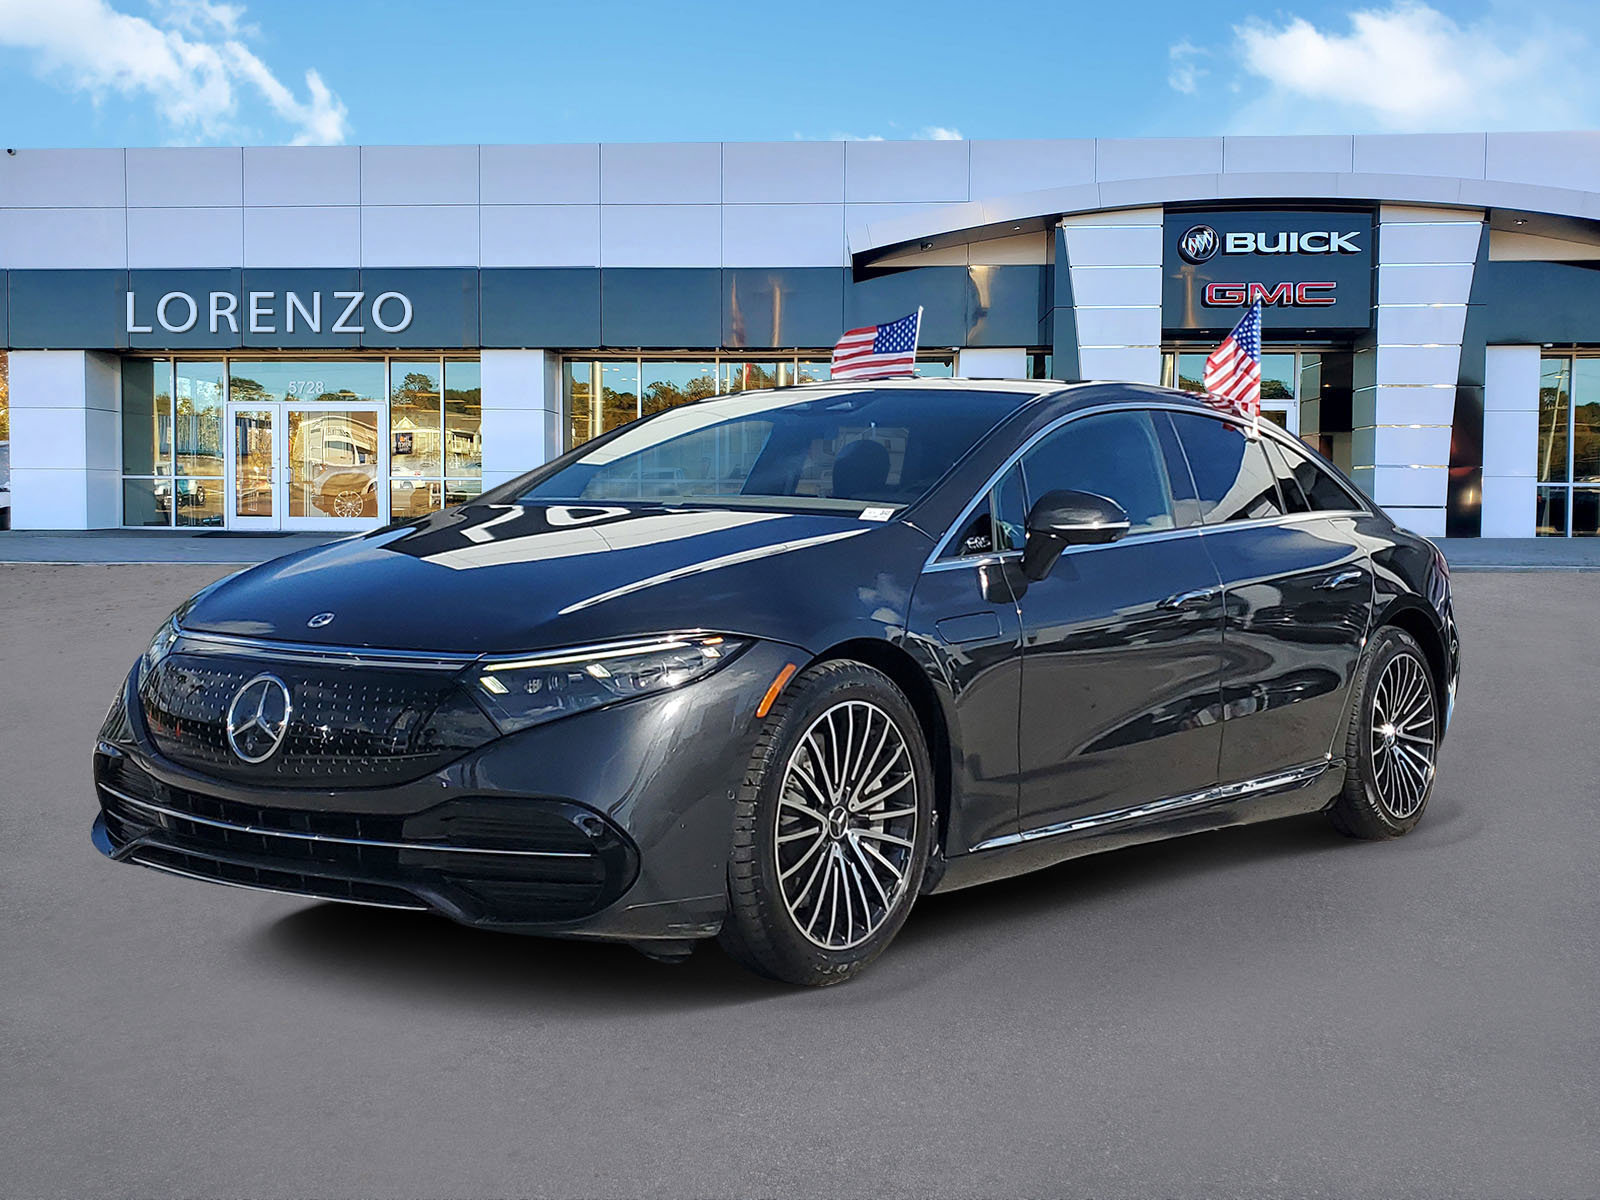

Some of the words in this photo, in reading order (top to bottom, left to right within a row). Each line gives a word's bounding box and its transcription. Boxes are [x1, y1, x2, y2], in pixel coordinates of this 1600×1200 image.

[1225, 231, 1362, 254] BUICK
[1205, 281, 1337, 305] GMC
[126, 291, 413, 333] LORENZO
[288, 380, 325, 394] 5728
